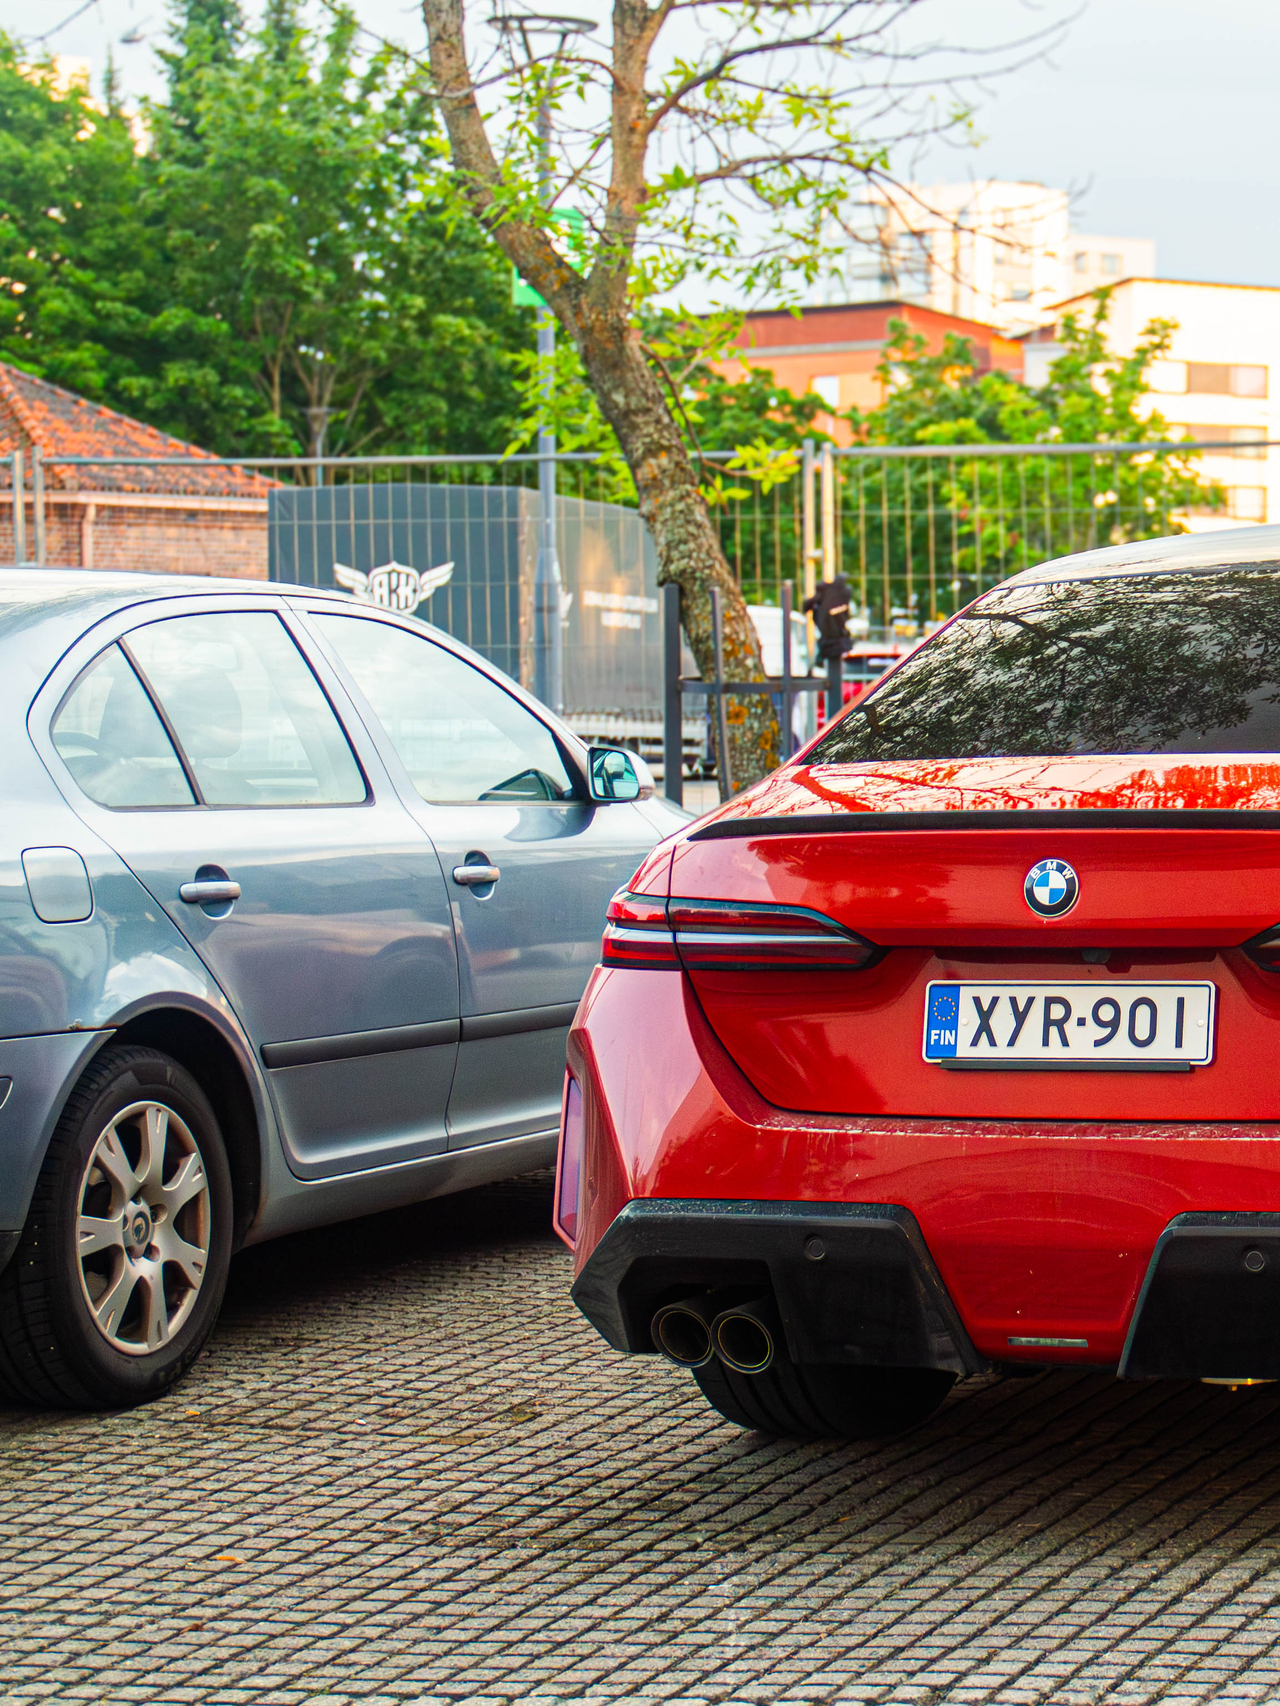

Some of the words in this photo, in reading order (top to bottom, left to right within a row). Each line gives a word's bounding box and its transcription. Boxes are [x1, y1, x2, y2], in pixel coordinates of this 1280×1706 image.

[1030, 861, 1074, 880] BMW
[969, 995, 1185, 1049] XYR-901
[930, 1030, 956, 1046] FIN
